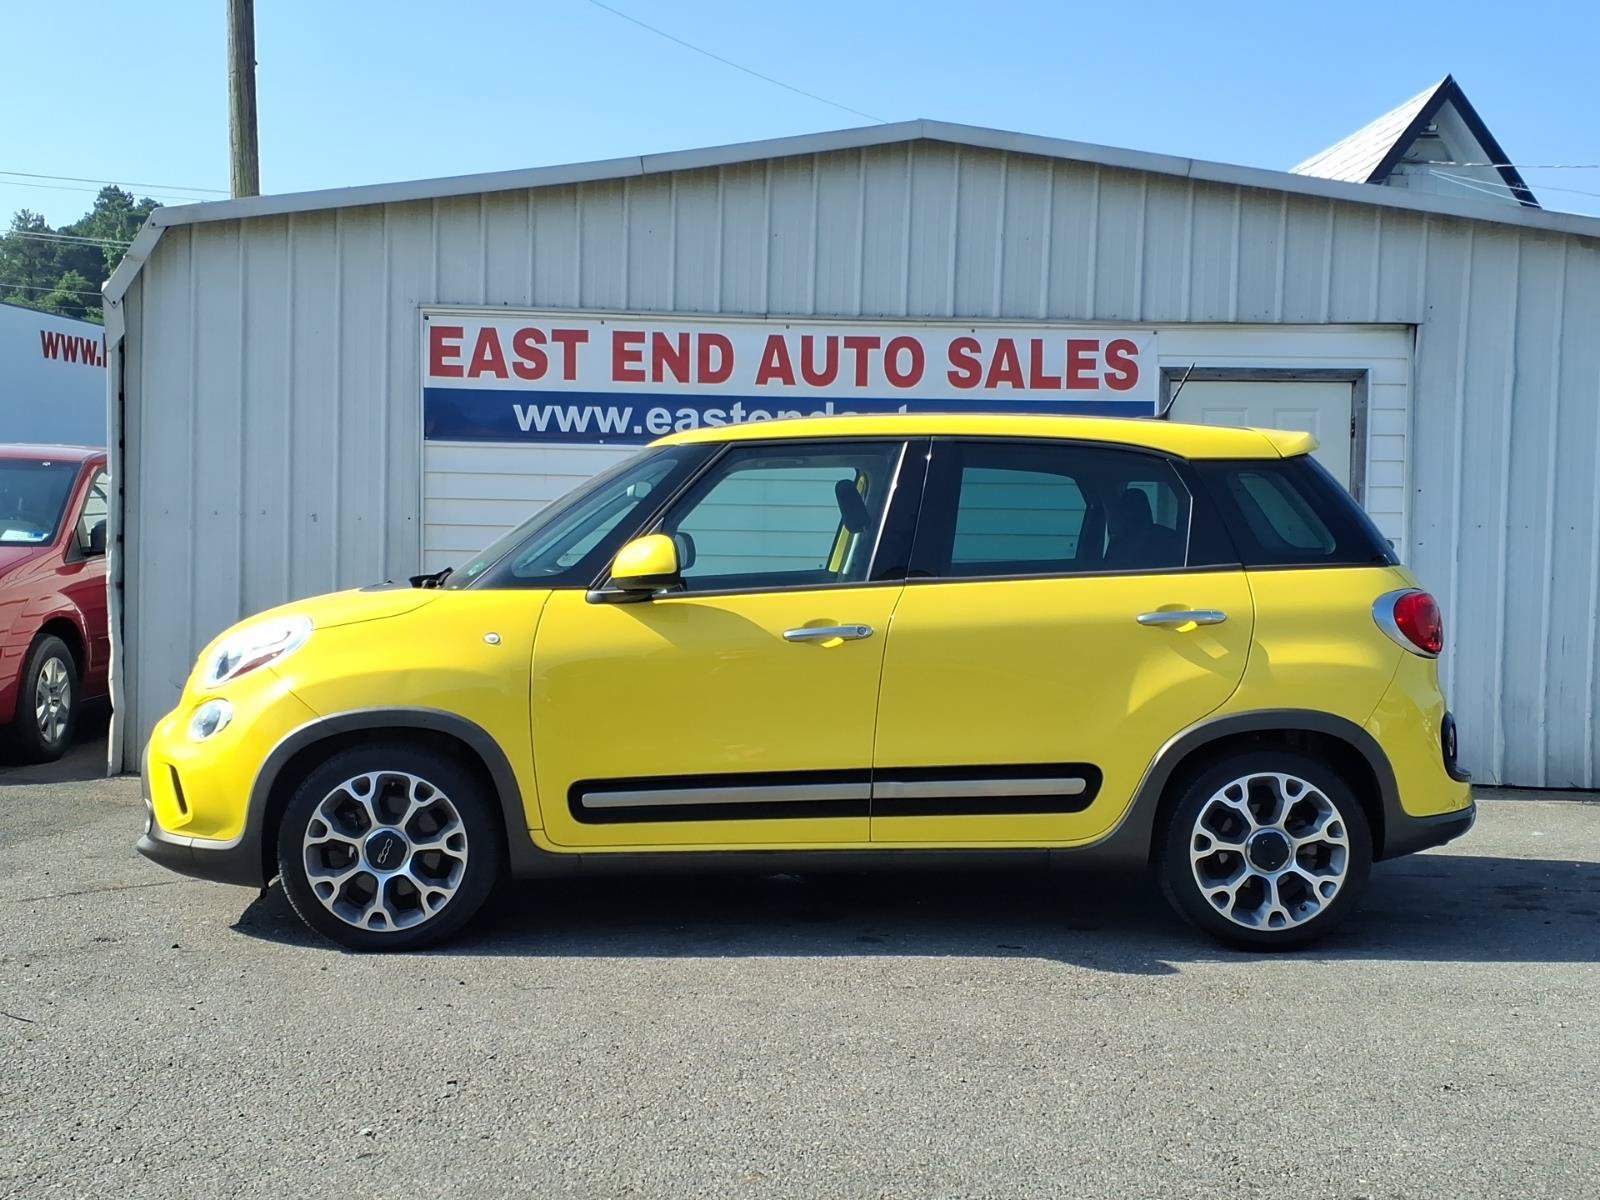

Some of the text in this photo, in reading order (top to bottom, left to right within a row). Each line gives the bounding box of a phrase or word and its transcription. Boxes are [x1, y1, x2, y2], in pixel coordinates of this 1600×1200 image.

[429, 326, 1140, 391] EAST END AUTO SALES
